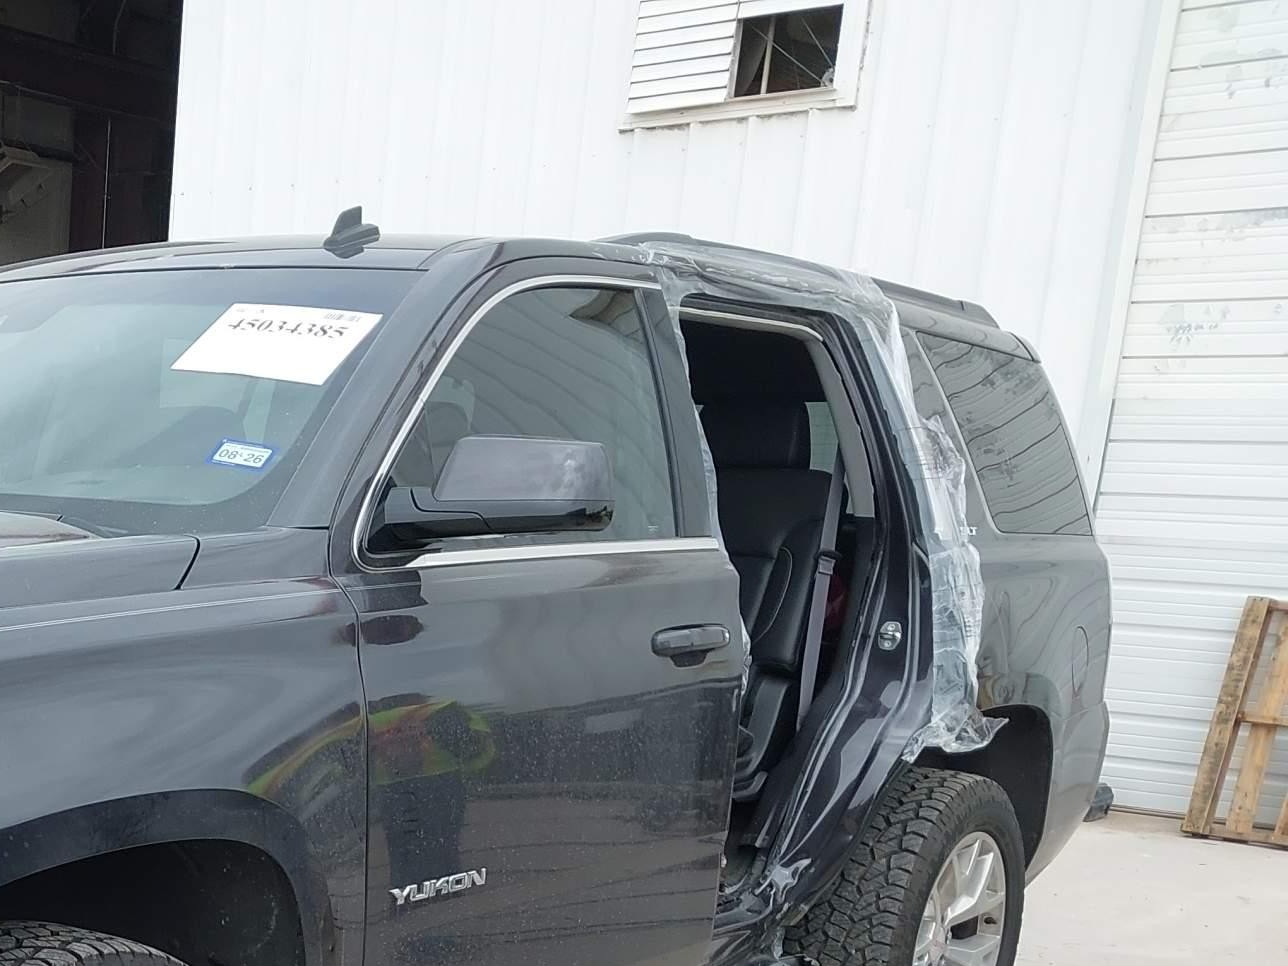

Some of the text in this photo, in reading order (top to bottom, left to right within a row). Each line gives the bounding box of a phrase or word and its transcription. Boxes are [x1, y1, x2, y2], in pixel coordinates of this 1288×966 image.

[227, 318, 349, 339] 45034385
[218, 448, 239, 460] 08
[242, 453, 265, 464] 26
[388, 867, 488, 905] YUKON
